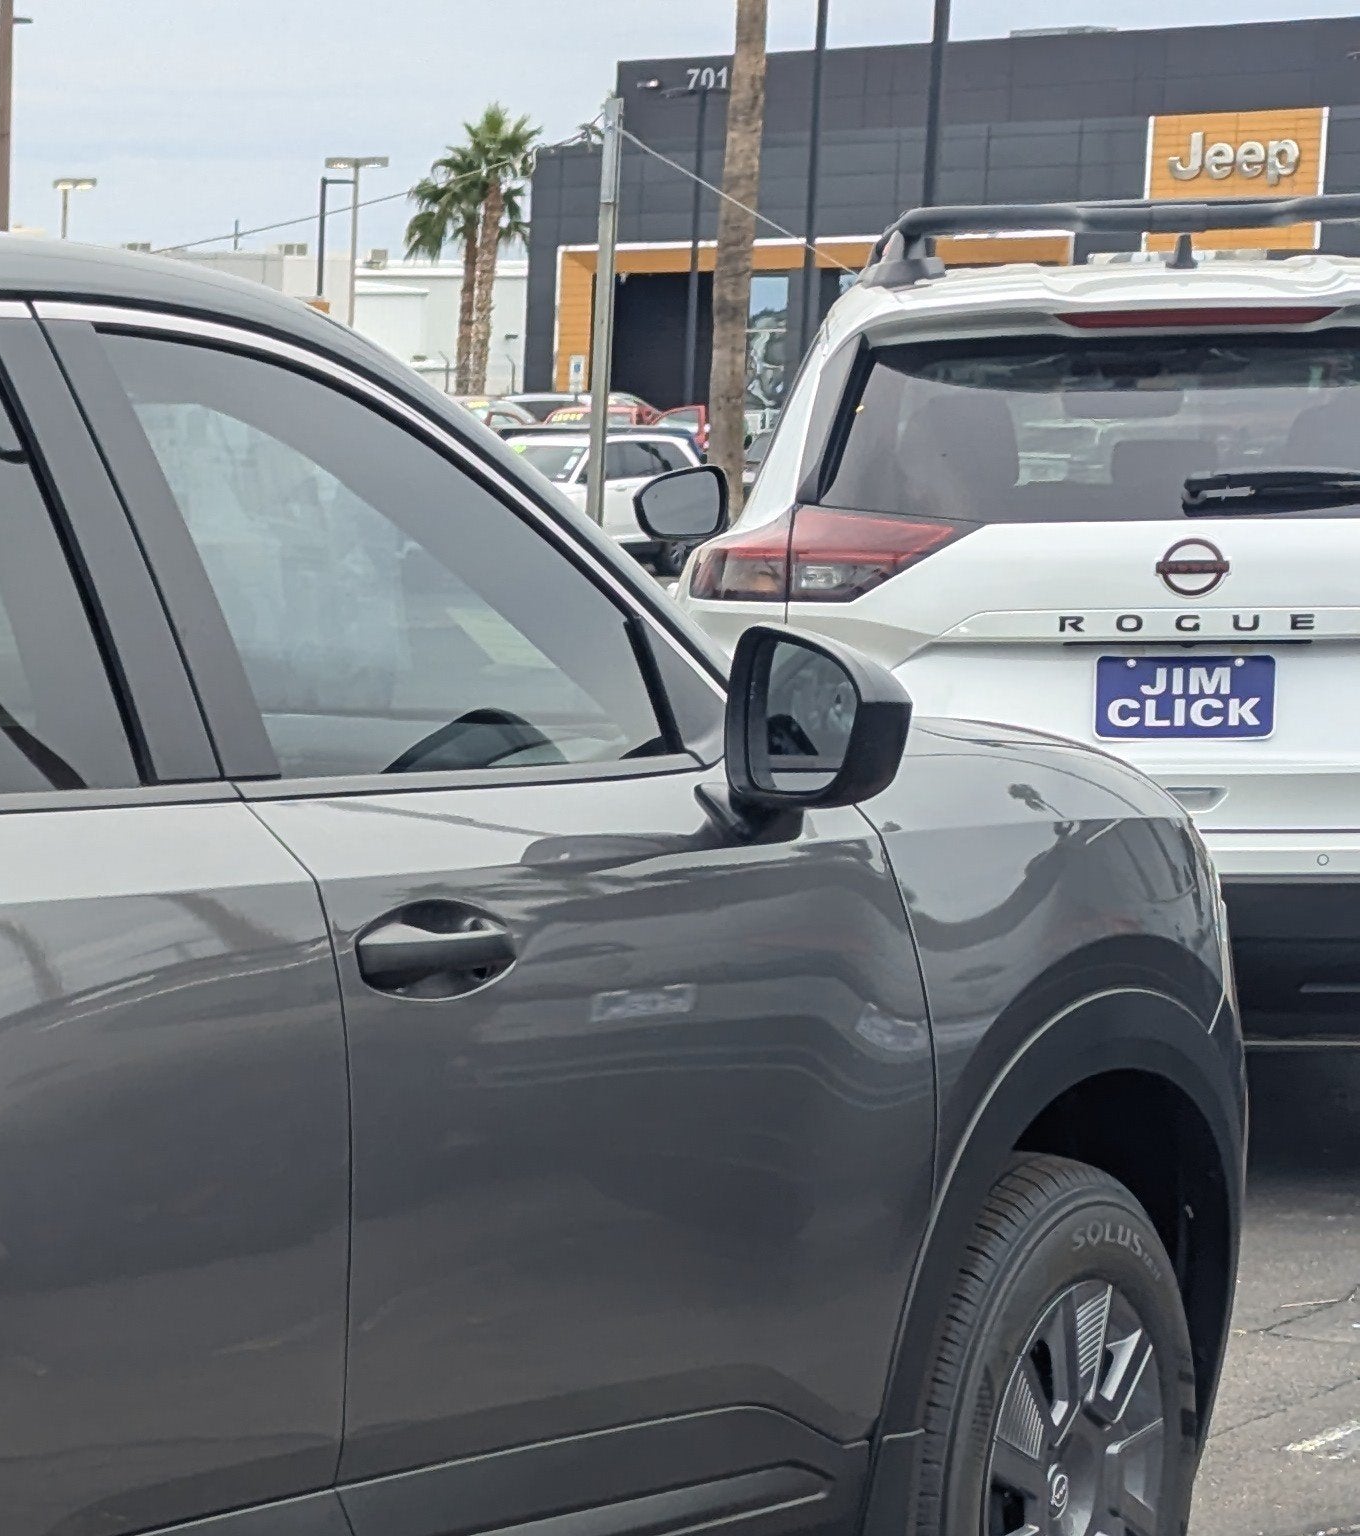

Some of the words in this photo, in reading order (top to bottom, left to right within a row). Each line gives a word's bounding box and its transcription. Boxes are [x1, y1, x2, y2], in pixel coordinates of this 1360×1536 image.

[686, 65, 728, 91] 701
[1168, 131, 1300, 186] Jeep
[1058, 613, 1315, 633] ROGUE
[1139, 666, 1231, 696] JIM
[1106, 697, 1261, 728] CLICK
[1071, 1221, 1144, 1258] SOLUS
